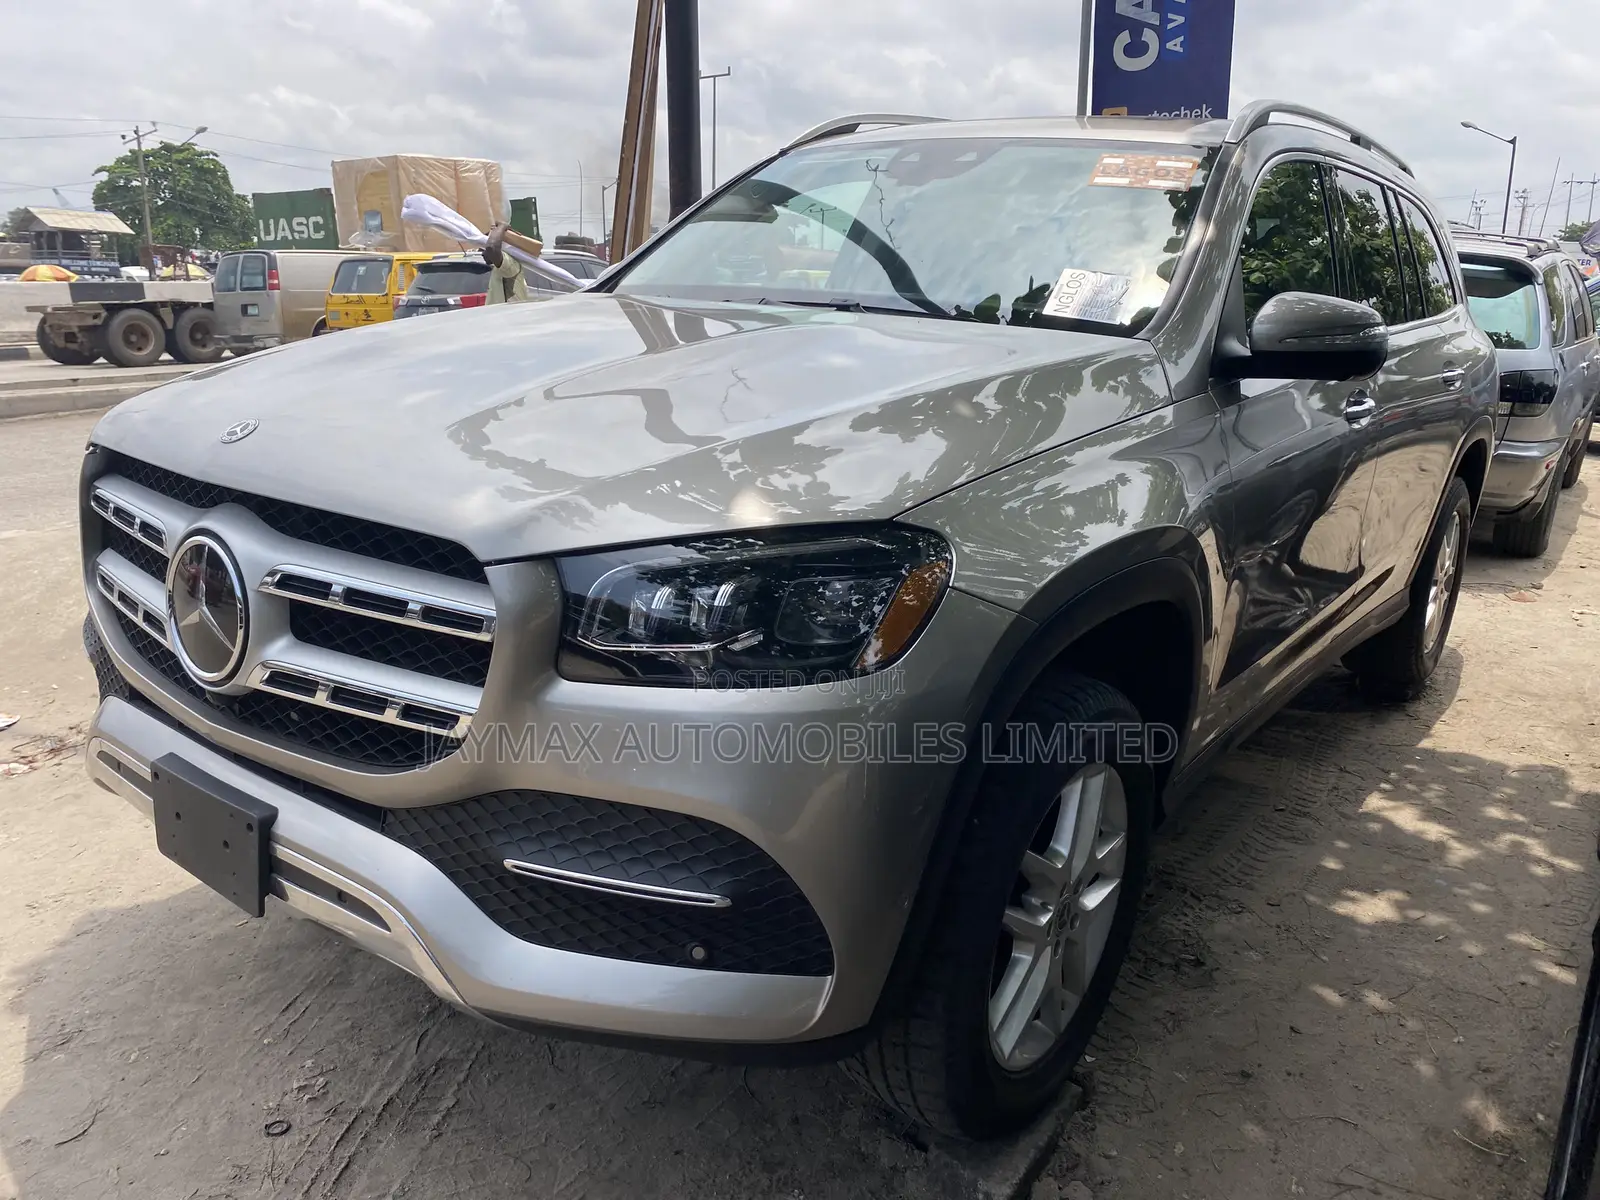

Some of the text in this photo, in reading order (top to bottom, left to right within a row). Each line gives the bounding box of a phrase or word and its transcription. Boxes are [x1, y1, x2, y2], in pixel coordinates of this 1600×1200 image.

[1100, 165, 1189, 179] LAGOS
[258, 215, 326, 241] UASC
[1052, 271, 1087, 314] NGLOS
